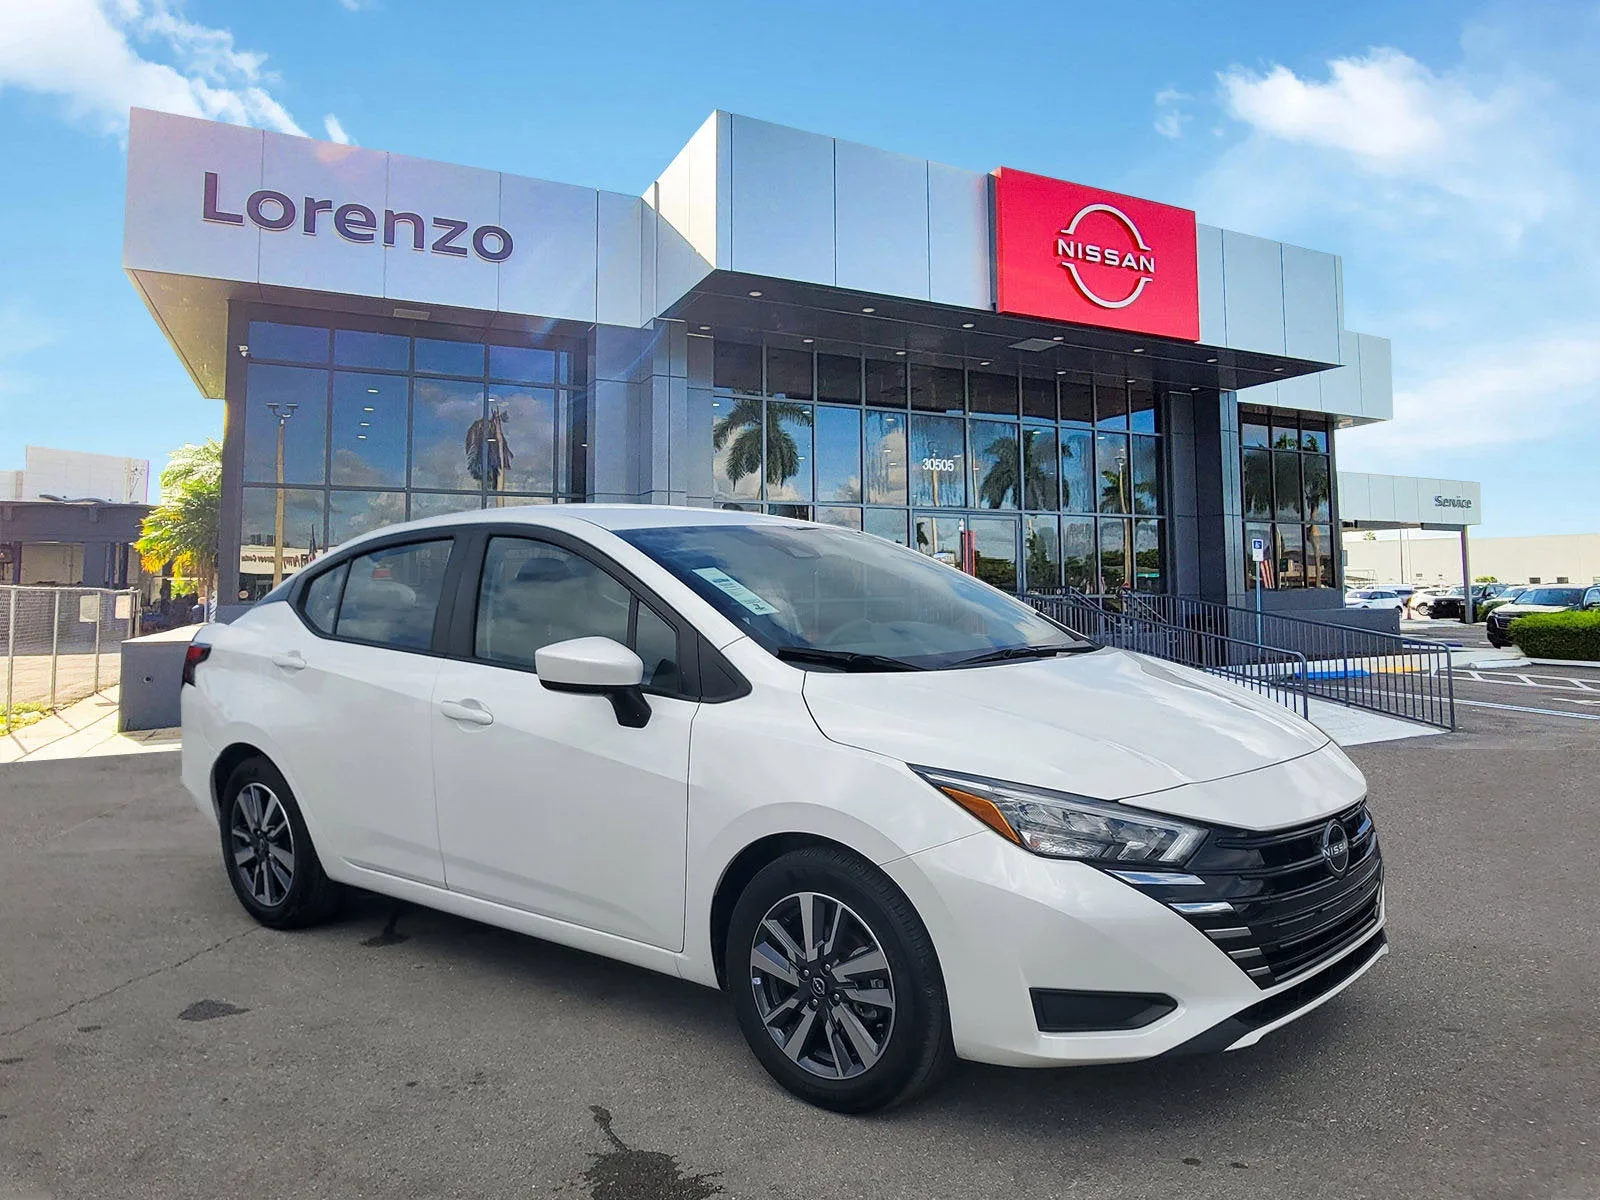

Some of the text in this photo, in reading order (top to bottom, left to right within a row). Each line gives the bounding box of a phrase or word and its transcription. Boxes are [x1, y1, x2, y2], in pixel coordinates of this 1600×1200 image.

[202, 171, 514, 263] Lorenzo
[1057, 238, 1155, 273] NISSAN
[922, 458, 955, 472] 30505
[1434, 495, 1473, 509] Service
